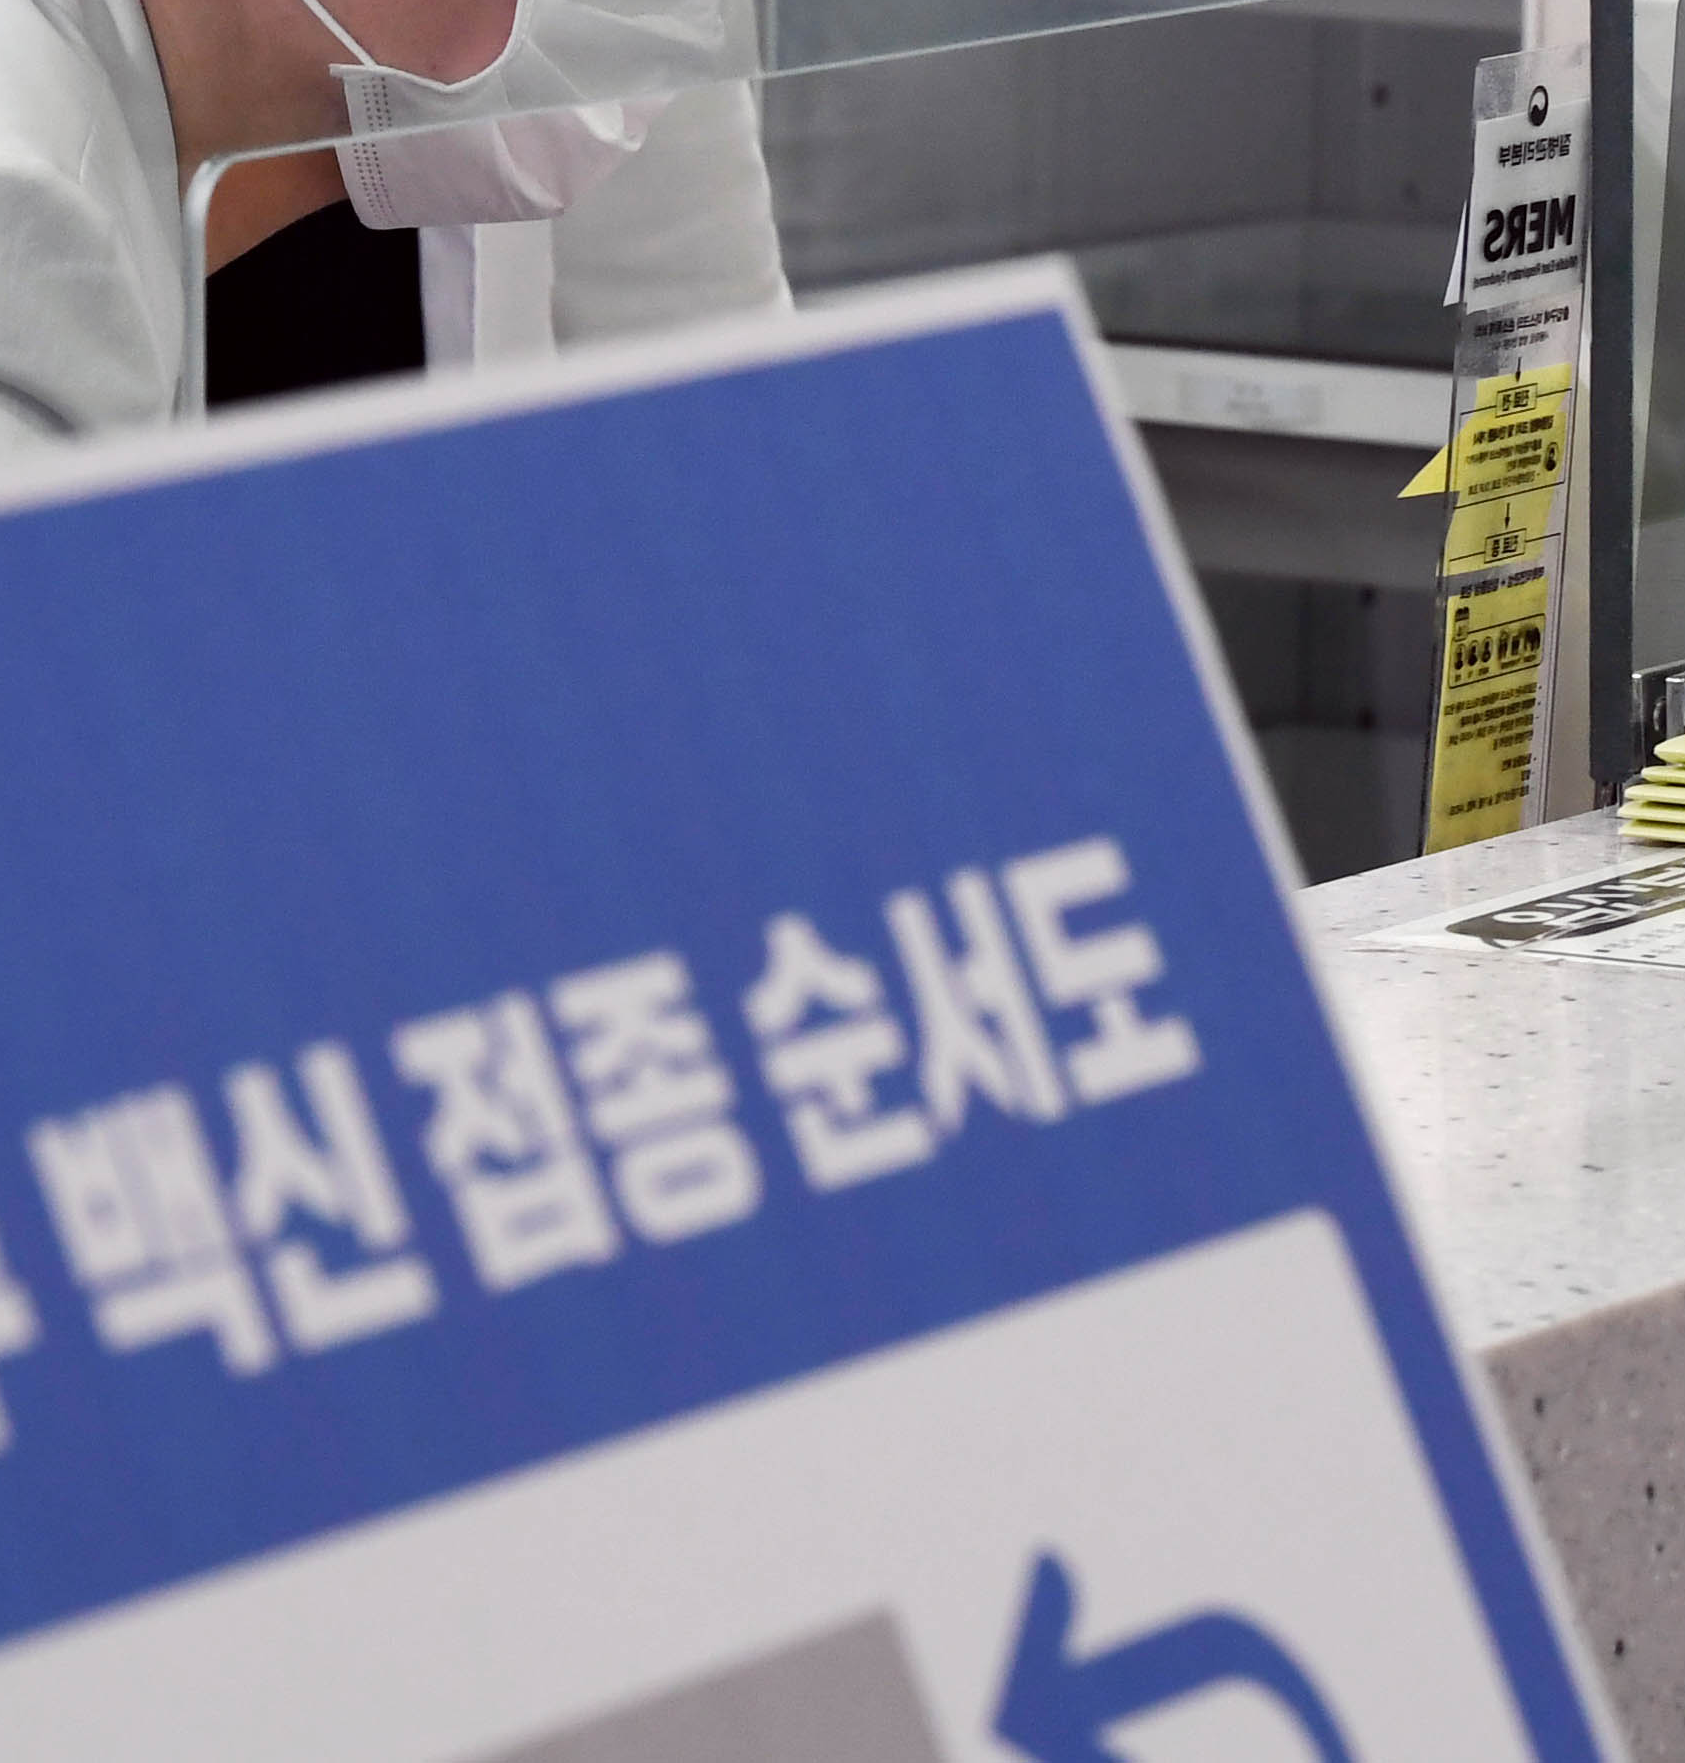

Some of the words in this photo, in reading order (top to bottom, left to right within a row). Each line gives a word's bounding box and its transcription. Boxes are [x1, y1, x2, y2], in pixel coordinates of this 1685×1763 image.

[26, 1039, 443, 1383] 백신
[387, 945, 768, 1301] 접종
[740, 833, 1203, 1194] 순서도
